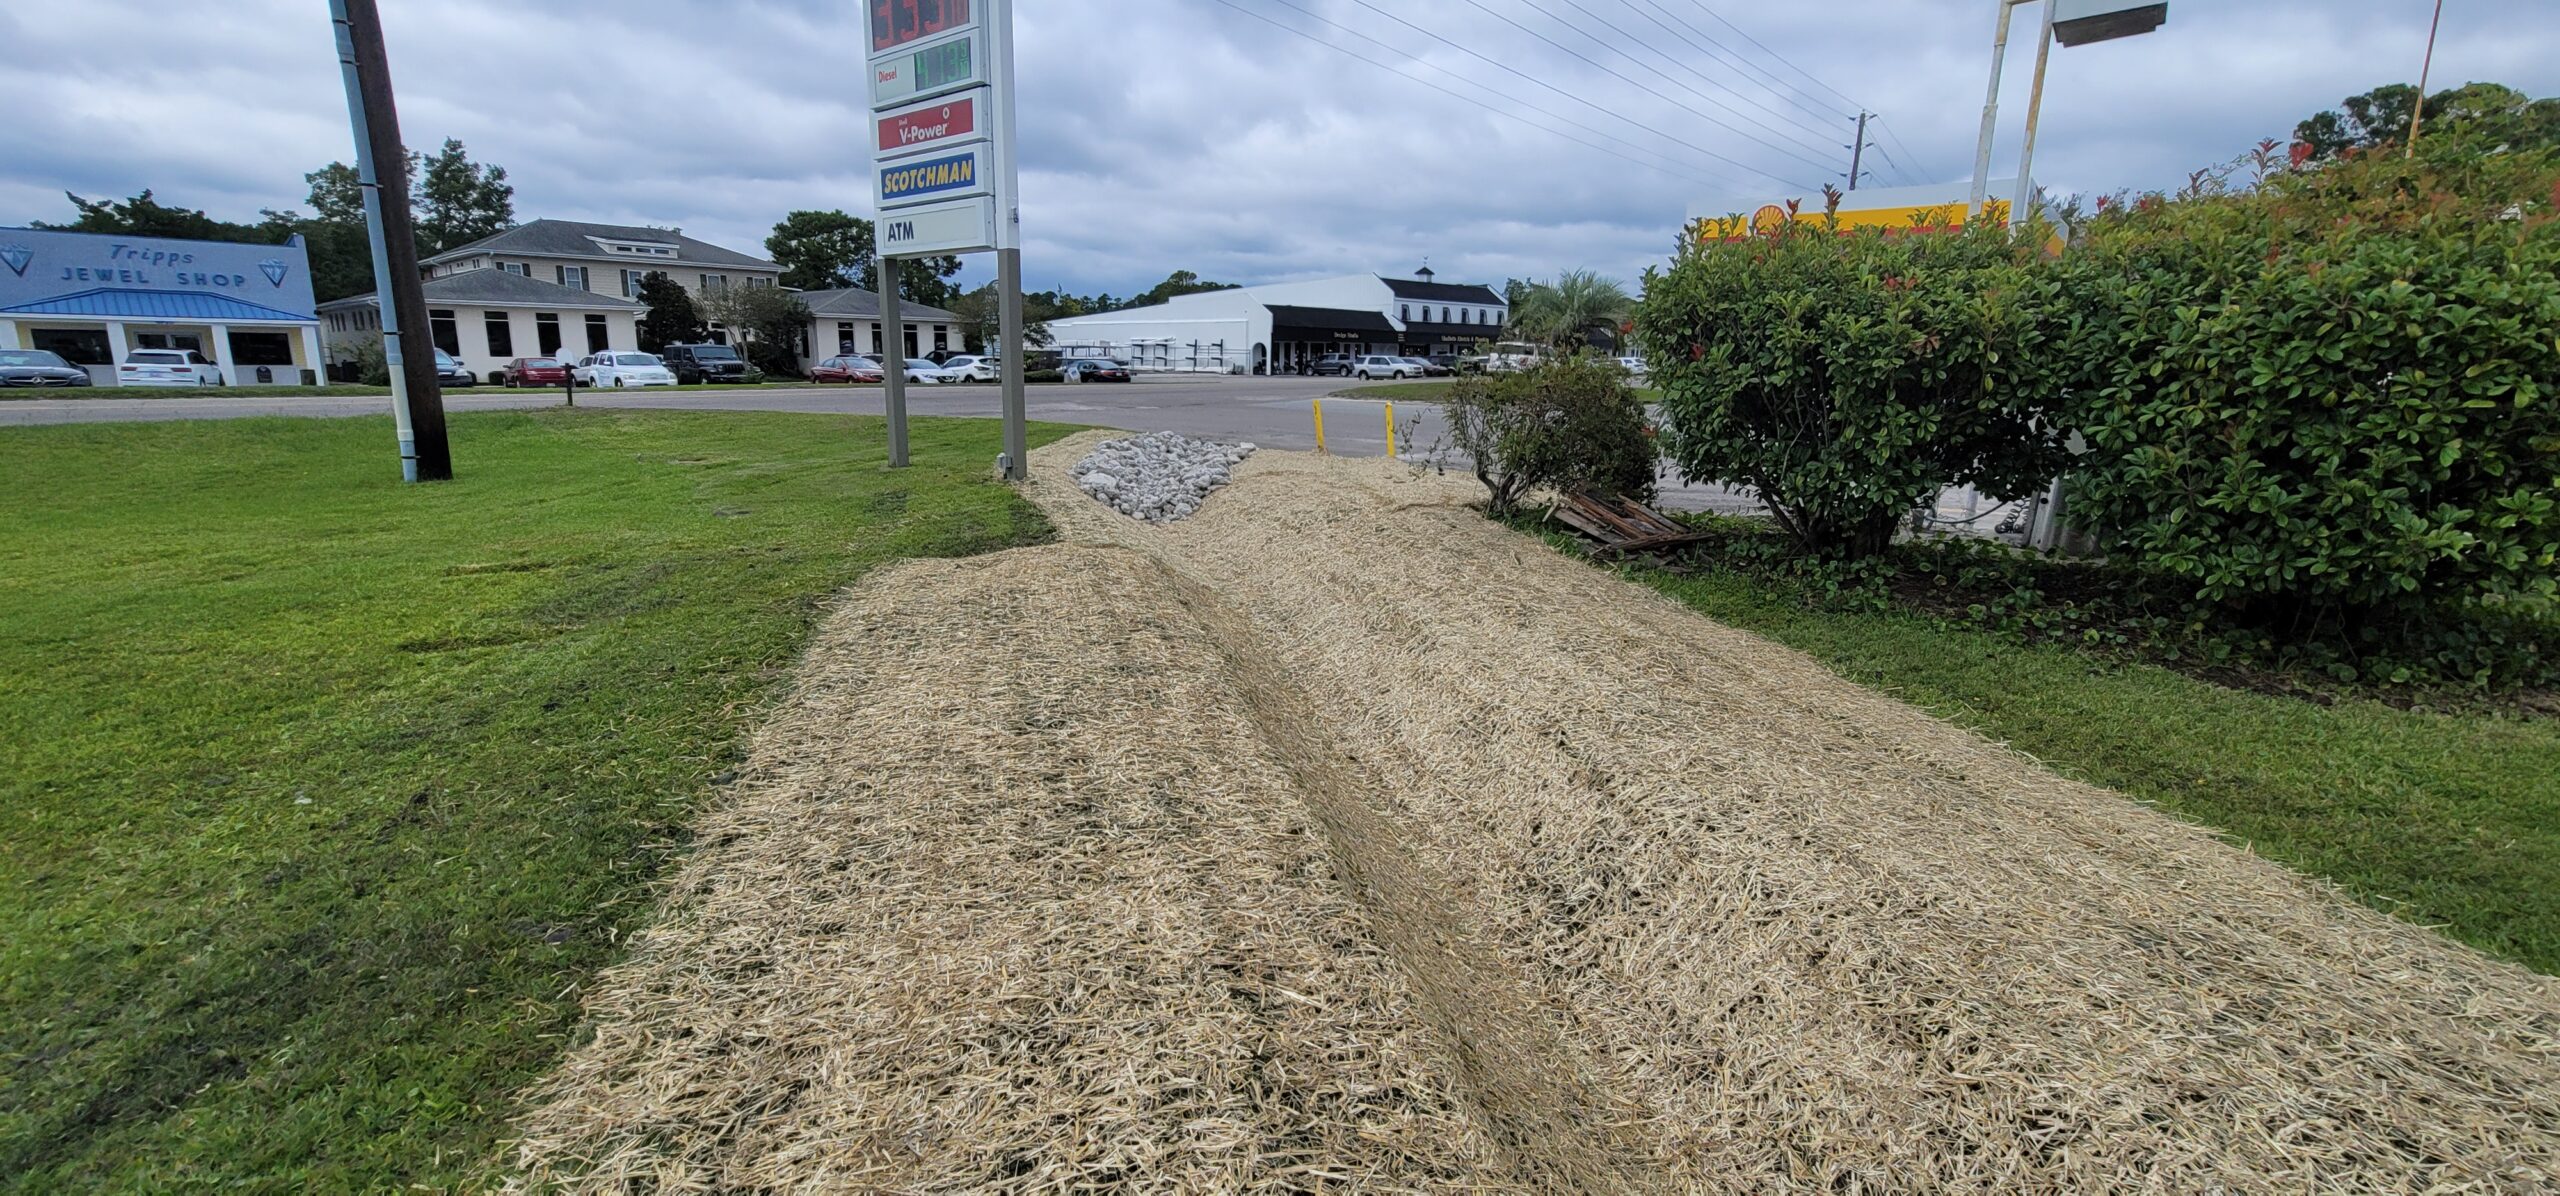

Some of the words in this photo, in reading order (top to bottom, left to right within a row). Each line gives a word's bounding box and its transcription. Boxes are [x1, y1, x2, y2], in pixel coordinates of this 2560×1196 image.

[878, 65, 897, 83] Diesel
[899, 122, 948, 144] V-Power
[884, 159, 972, 193] SCOTCHMAN
[887, 221, 914, 242] ATM
[110, 244, 195, 267] Tripps
[60, 267, 149, 284] JEWEL
[176, 272, 246, 287] SHOP
